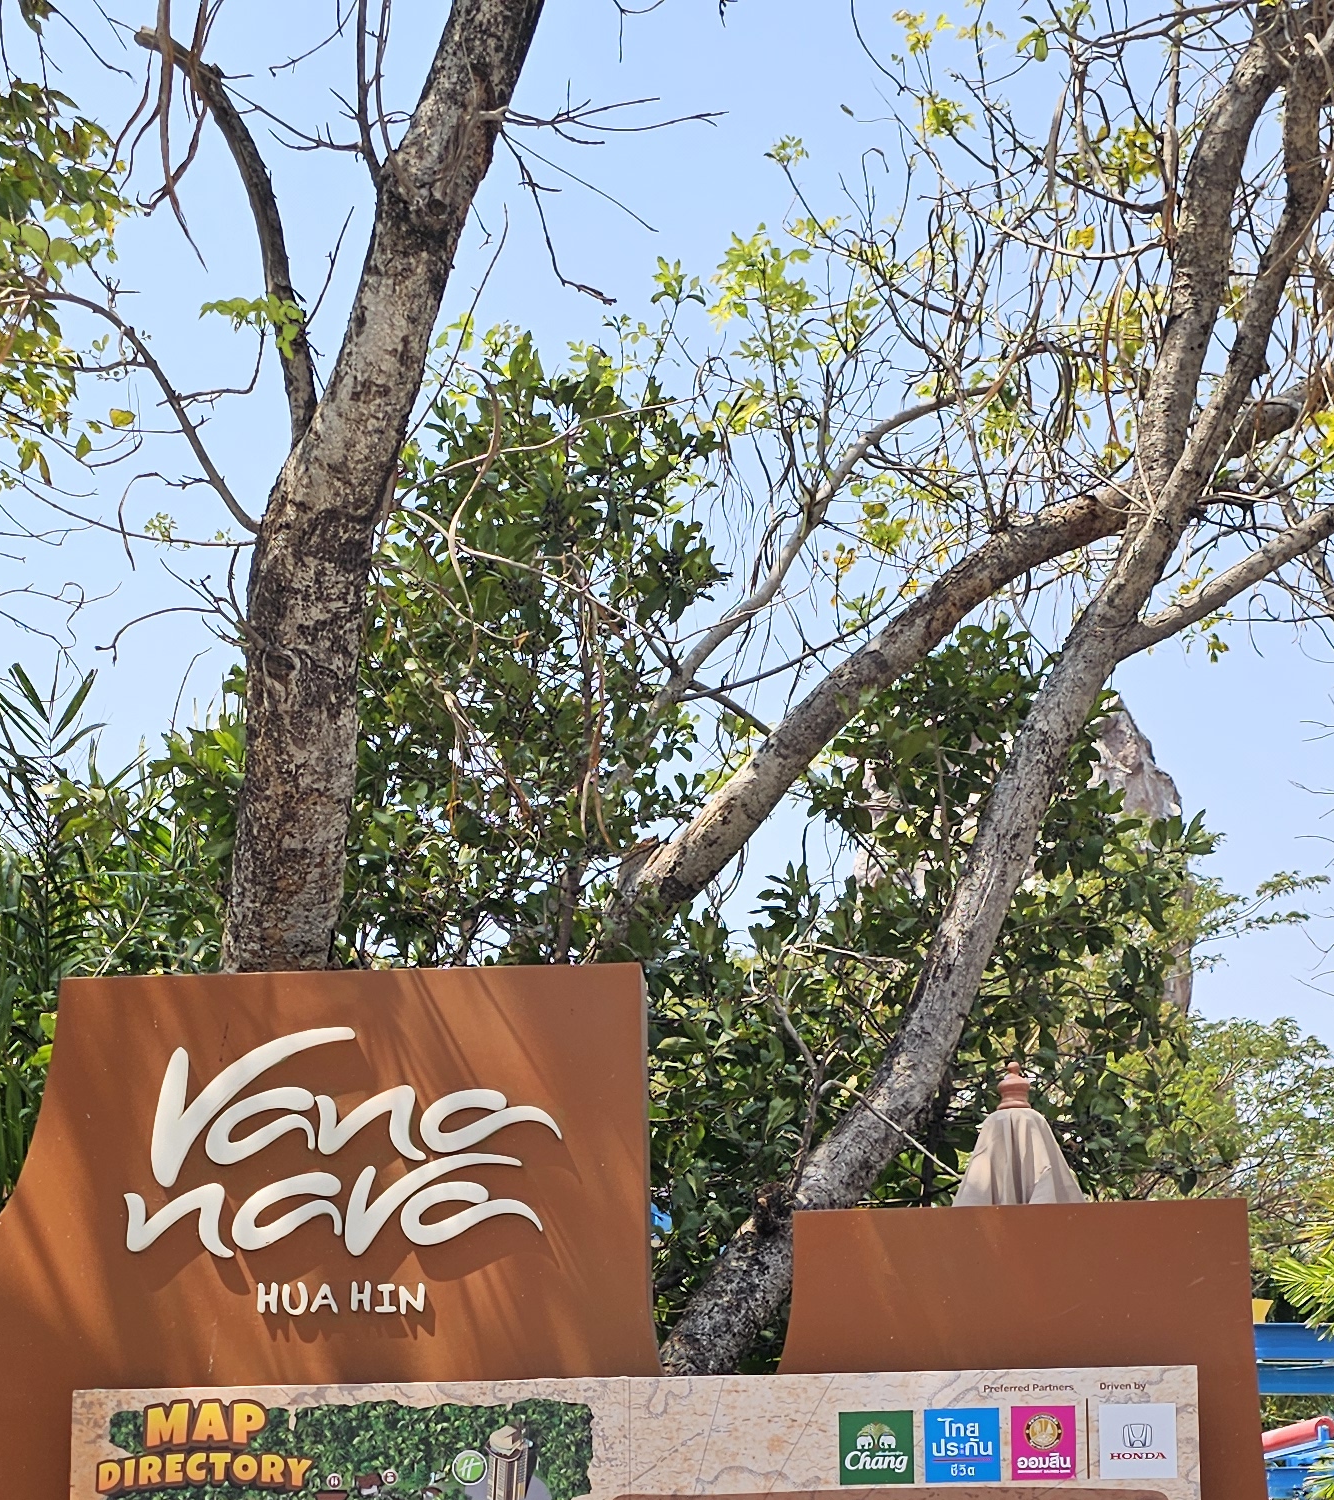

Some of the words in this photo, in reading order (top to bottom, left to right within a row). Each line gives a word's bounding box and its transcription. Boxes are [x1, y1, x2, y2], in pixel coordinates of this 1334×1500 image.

[256, 1281, 339, 1316] HUA
[350, 1281, 426, 1315] HIN
[984, 1384, 1030, 1393] Preferred
[1033, 1383, 1074, 1391] Partners
[1099, 1382, 1129, 1391] Driven
[1132, 1382, 1146, 1392] by
[146, 1402, 266, 1447] MAP
[937, 1418, 979, 1438] ไทย
[932, 1438, 993, 1457] ประกัน
[1110, 1452, 1166, 1460] HONDA
[845, 1451, 908, 1472] Chang
[951, 1464, 975, 1477] ชีวิต
[1017, 1453, 1071, 1469] ออมสิน
[98, 1452, 312, 1491] DIRECTORY
